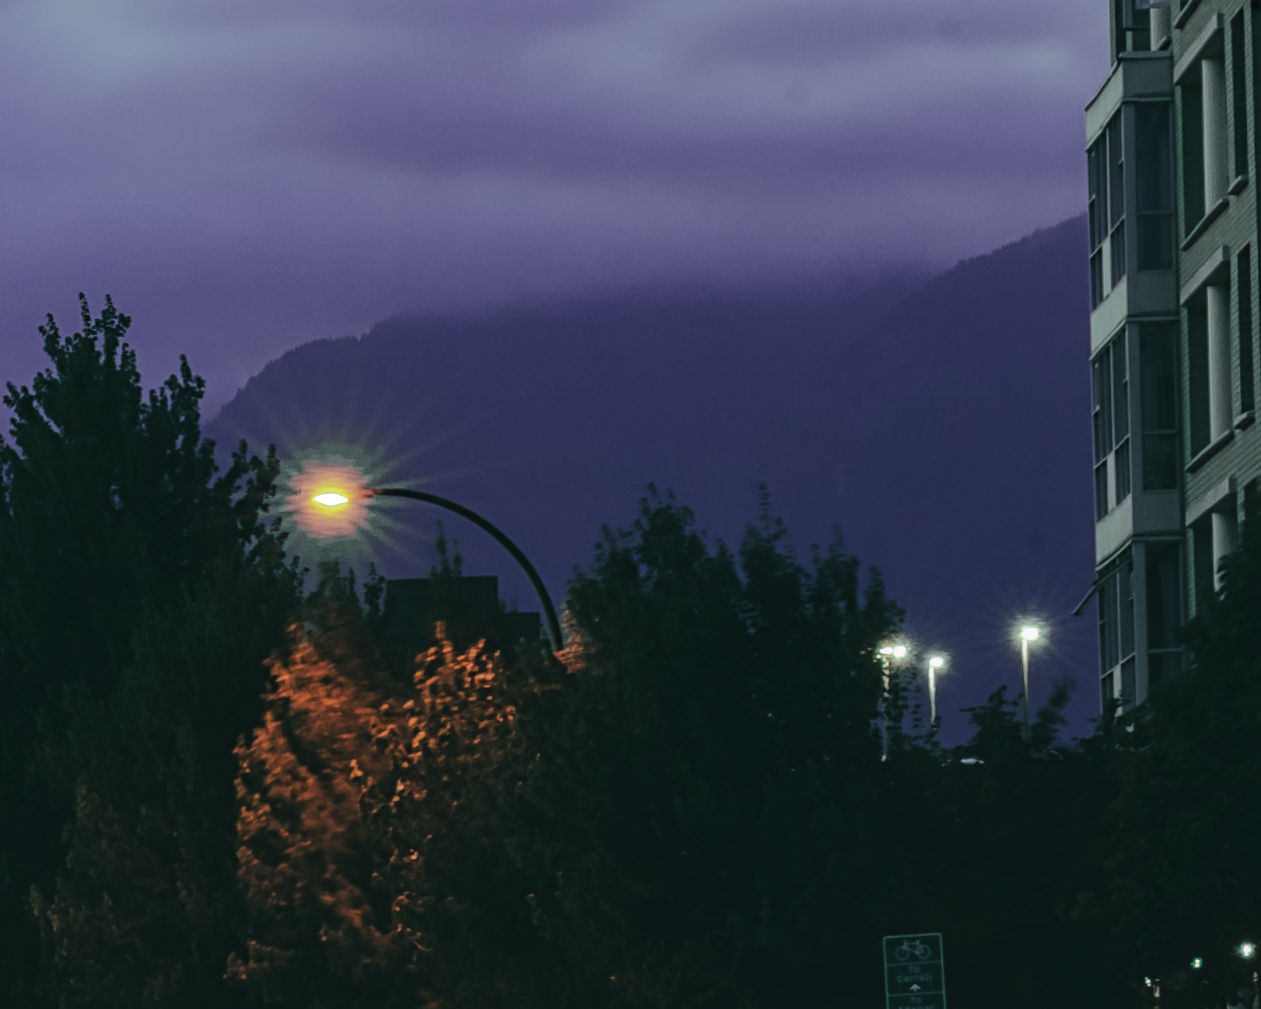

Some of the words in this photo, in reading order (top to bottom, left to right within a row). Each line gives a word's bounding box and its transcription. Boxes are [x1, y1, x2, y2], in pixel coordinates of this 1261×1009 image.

[908, 965, 920, 974] To
[896, 973, 933, 983] Carrall
[910, 996, 922, 1004] To
